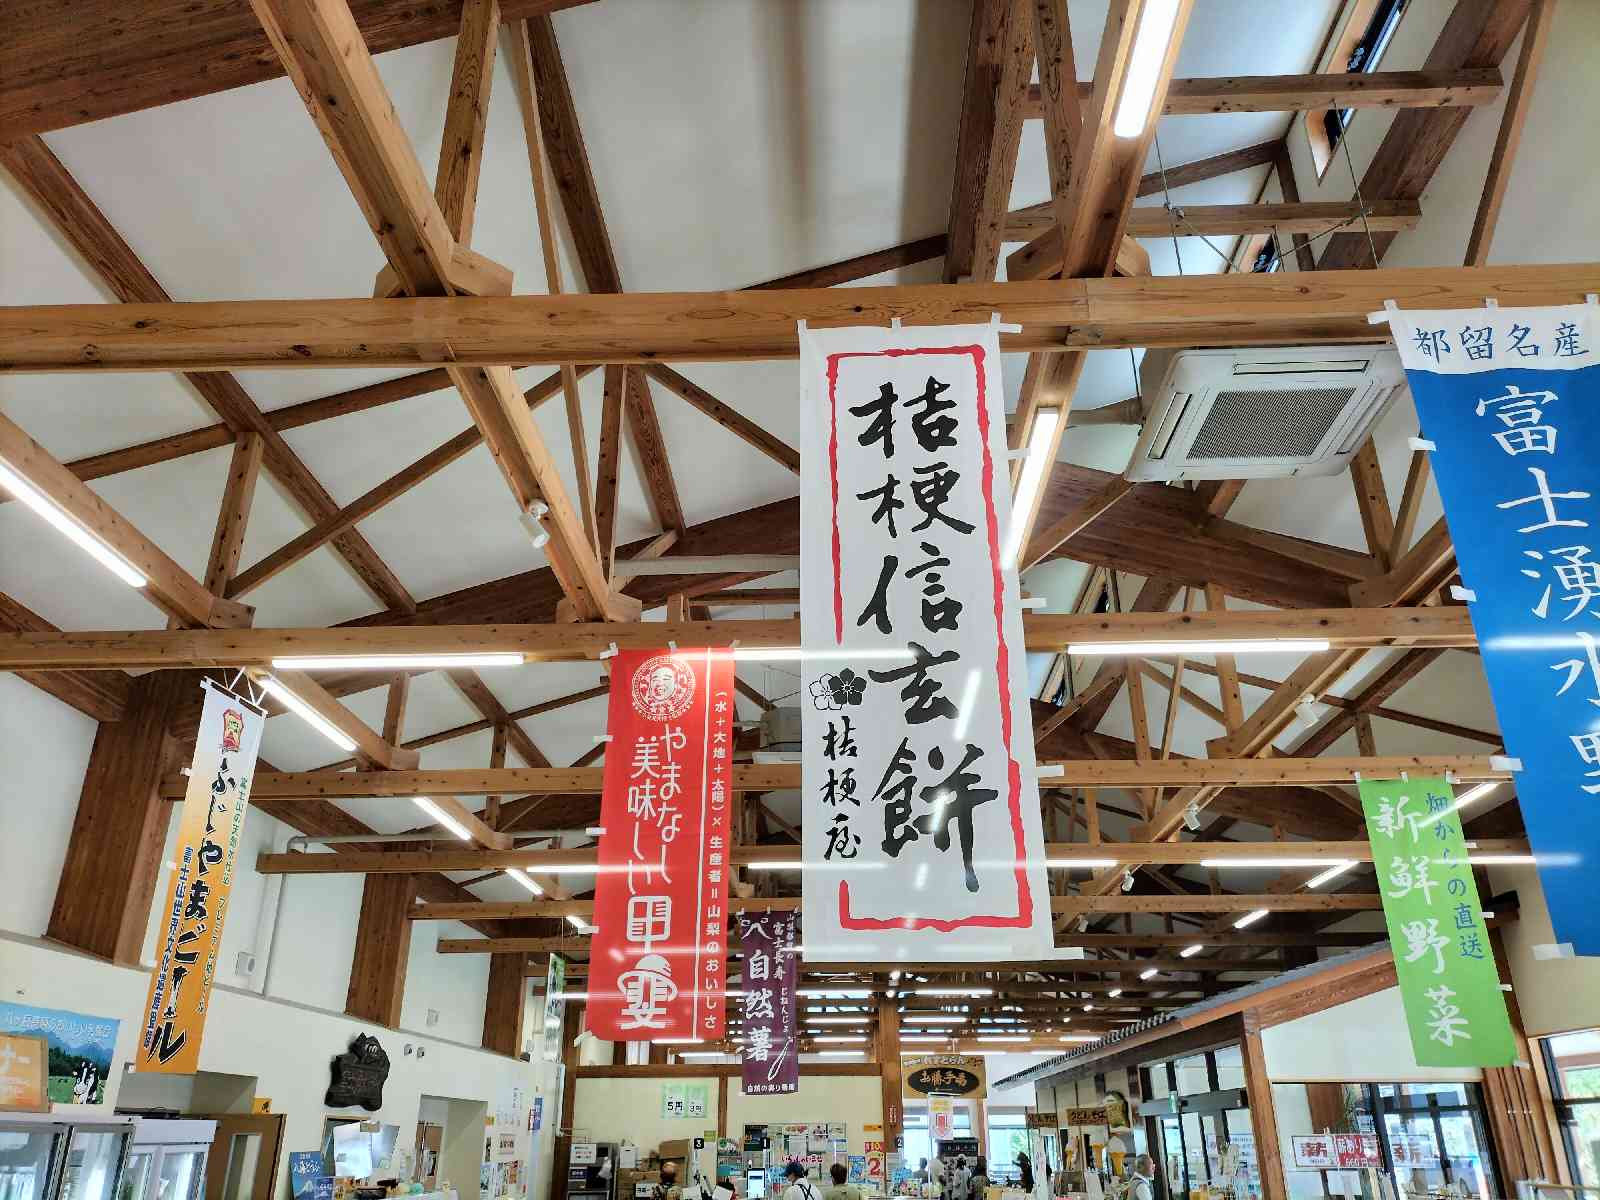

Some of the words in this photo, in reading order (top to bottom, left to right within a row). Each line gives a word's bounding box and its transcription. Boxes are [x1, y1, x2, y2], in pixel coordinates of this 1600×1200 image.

[1413, 321, 1590, 365] 都留名産
[848, 375, 999, 893] 桔梗信玄餅
[627, 736, 661, 895] 美味しい
[657, 723, 687, 884] やまなし
[820, 715, 862, 861] 桔梗屋
[1370, 795, 1472, 1047] 新鮮野菜
[1425, 792, 1484, 960] 畑からの直送
[745, 949, 775, 1062] 自然薯
